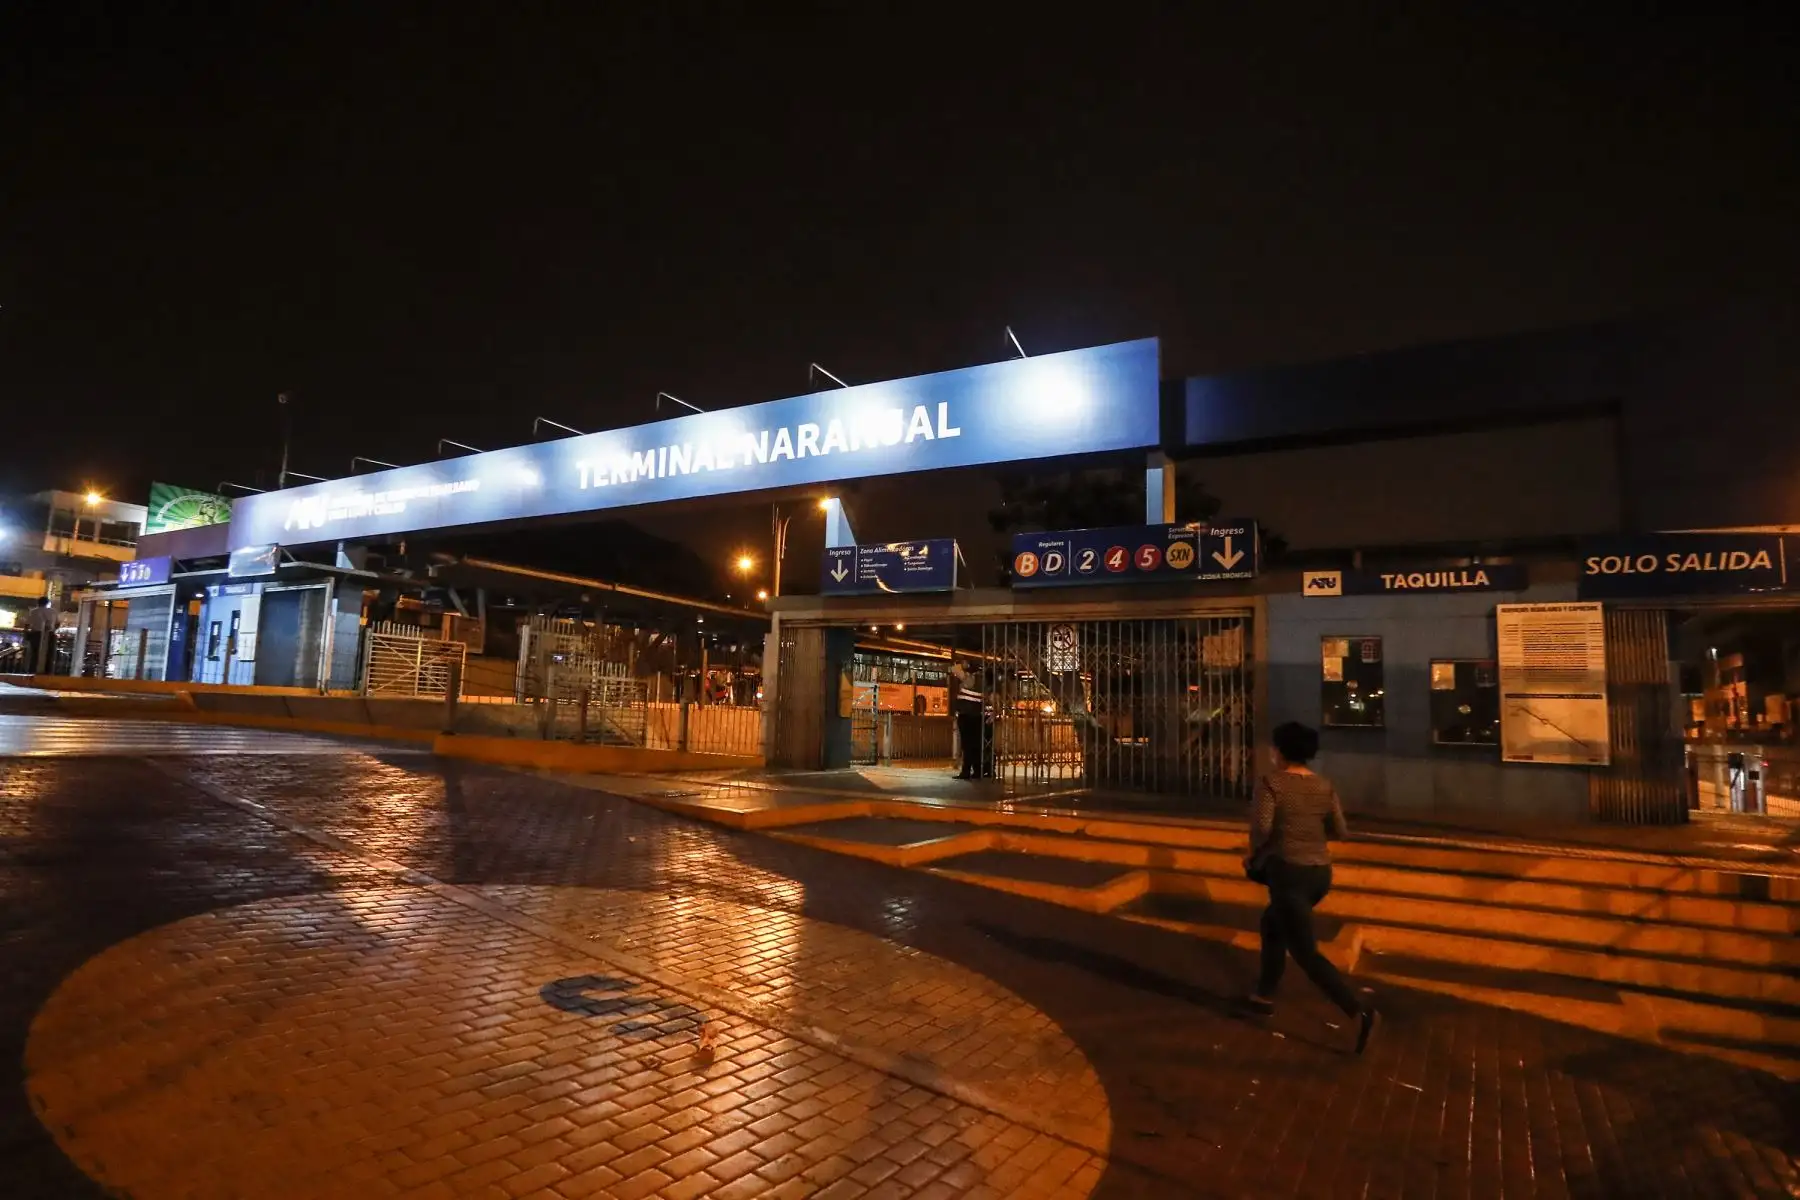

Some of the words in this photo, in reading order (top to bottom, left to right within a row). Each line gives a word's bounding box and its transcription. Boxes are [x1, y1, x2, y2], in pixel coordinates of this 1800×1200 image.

[575, 439, 739, 490] TERMINAL
[1210, 527, 1245, 537] Ingreso
[829, 549, 851, 558] Ingreso
[1019, 554, 1035, 574] B
[1044, 552, 1063, 573] D
[1080, 550, 1094, 571] 2
[1109, 549, 1124, 568] 4
[1140, 548, 1156, 567] 5
[1169, 548, 1191, 562] SXN
[1585, 555, 1658, 576] SOLO
[1665, 550, 1774, 573] SALIDA
[1308, 576, 1336, 589] ATU
[1381, 570, 1490, 589] TAQUILLA
